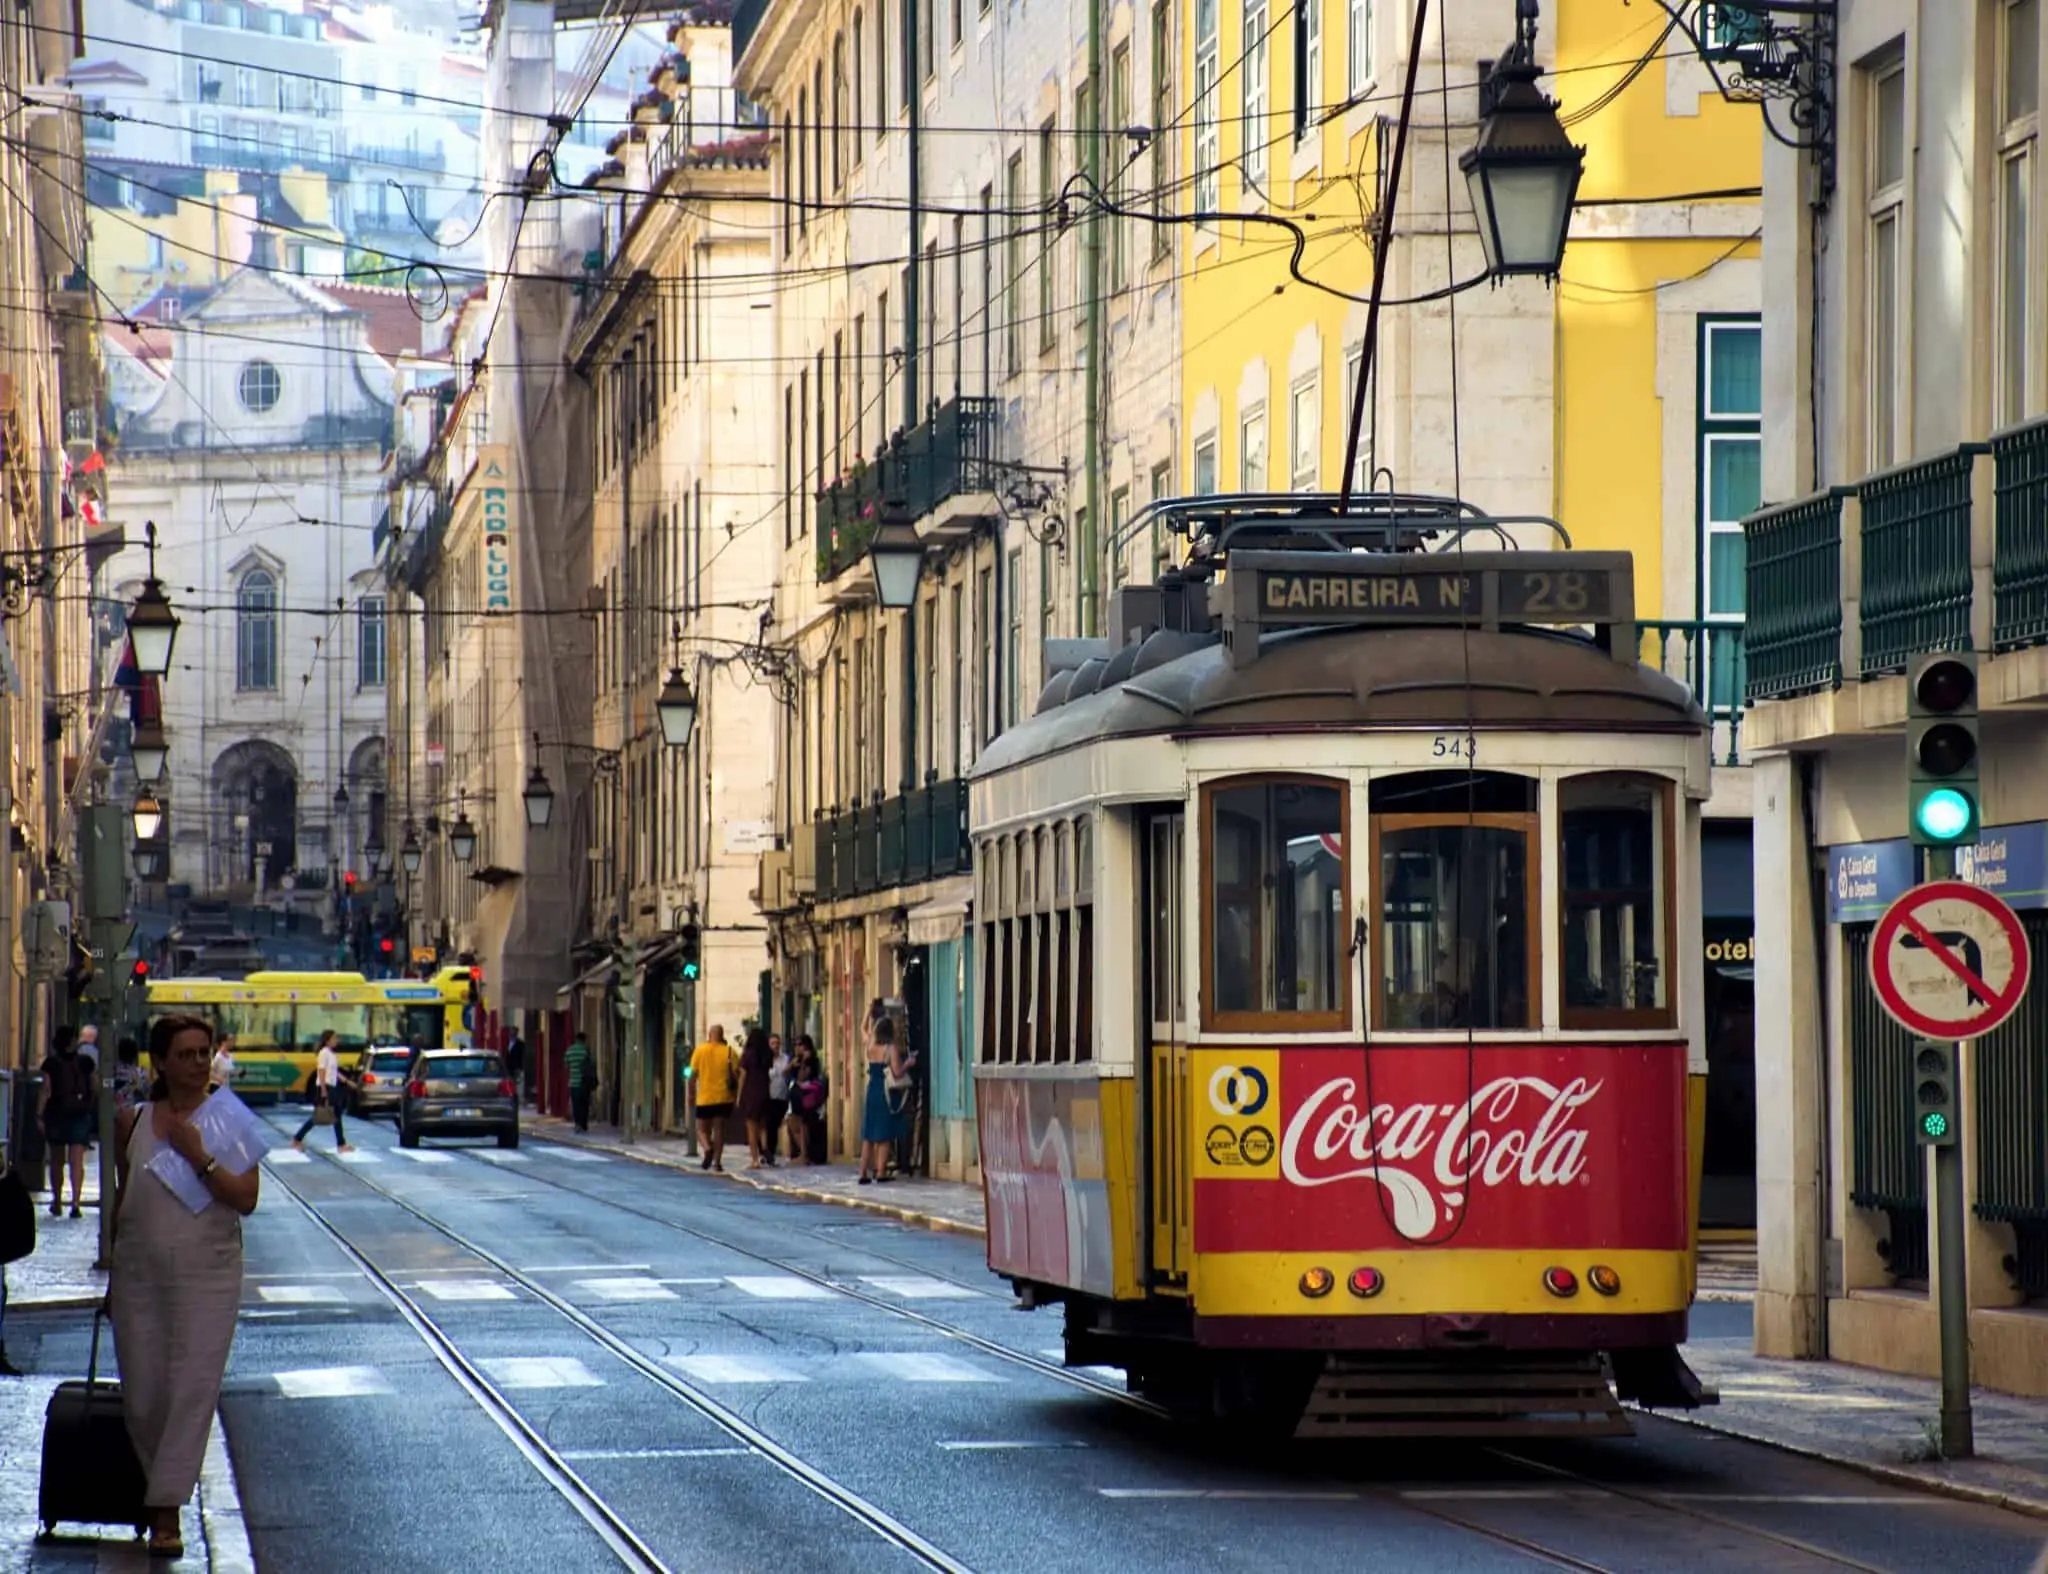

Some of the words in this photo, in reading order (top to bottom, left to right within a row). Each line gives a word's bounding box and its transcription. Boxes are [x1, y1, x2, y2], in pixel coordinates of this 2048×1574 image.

[1266, 577, 1421, 608] CARREIRA
[1522, 571, 1589, 614] 28
[1432, 736, 1476, 758] 543
[1281, 1077, 1604, 1238] Coca-Cola
